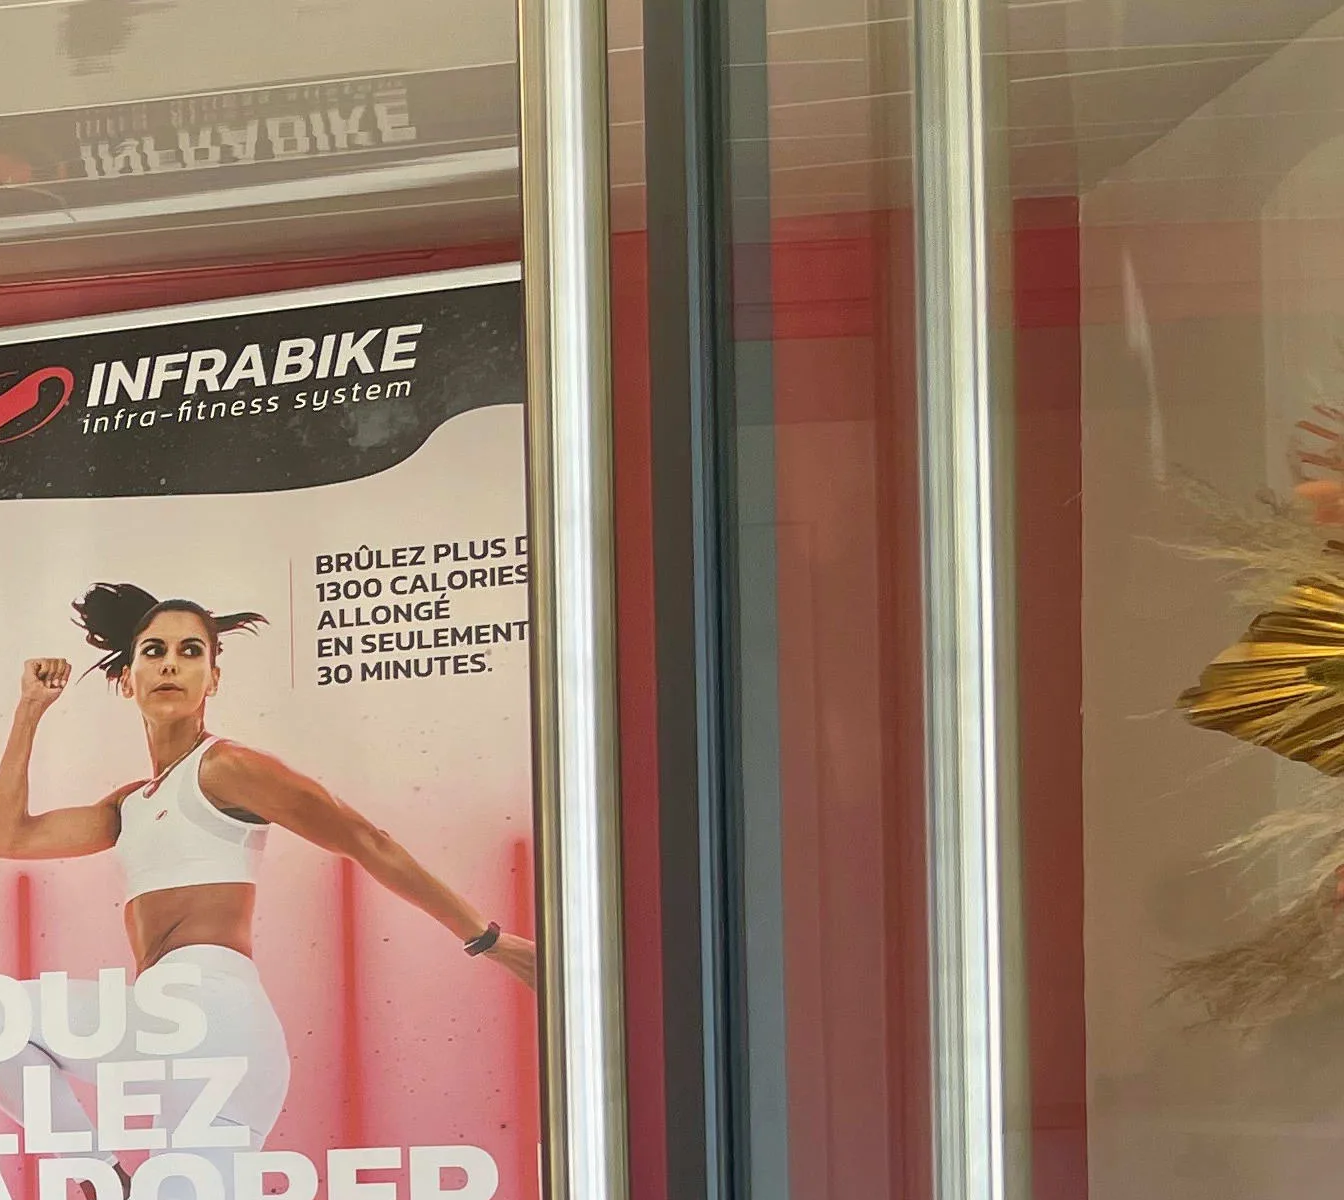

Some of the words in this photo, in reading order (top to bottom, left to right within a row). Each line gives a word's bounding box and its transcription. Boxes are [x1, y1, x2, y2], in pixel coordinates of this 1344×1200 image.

[85, 322, 423, 407] INFRABIKE
[82, 394, 279, 434] infra-fitness
[293, 379, 412, 412] system
[315, 544, 426, 575] BRÛLEZ
[433, 538, 507, 564] PLUS
[316, 578, 382, 602] 1300
[390, 564, 529, 596] CALORIES
[317, 593, 450, 630] ALLONGÉ
[317, 635, 353, 658] EN
[361, 620, 530, 654] SEULEMENT
[317, 664, 353, 686] 30
[361, 653, 493, 682] MINUTES.
